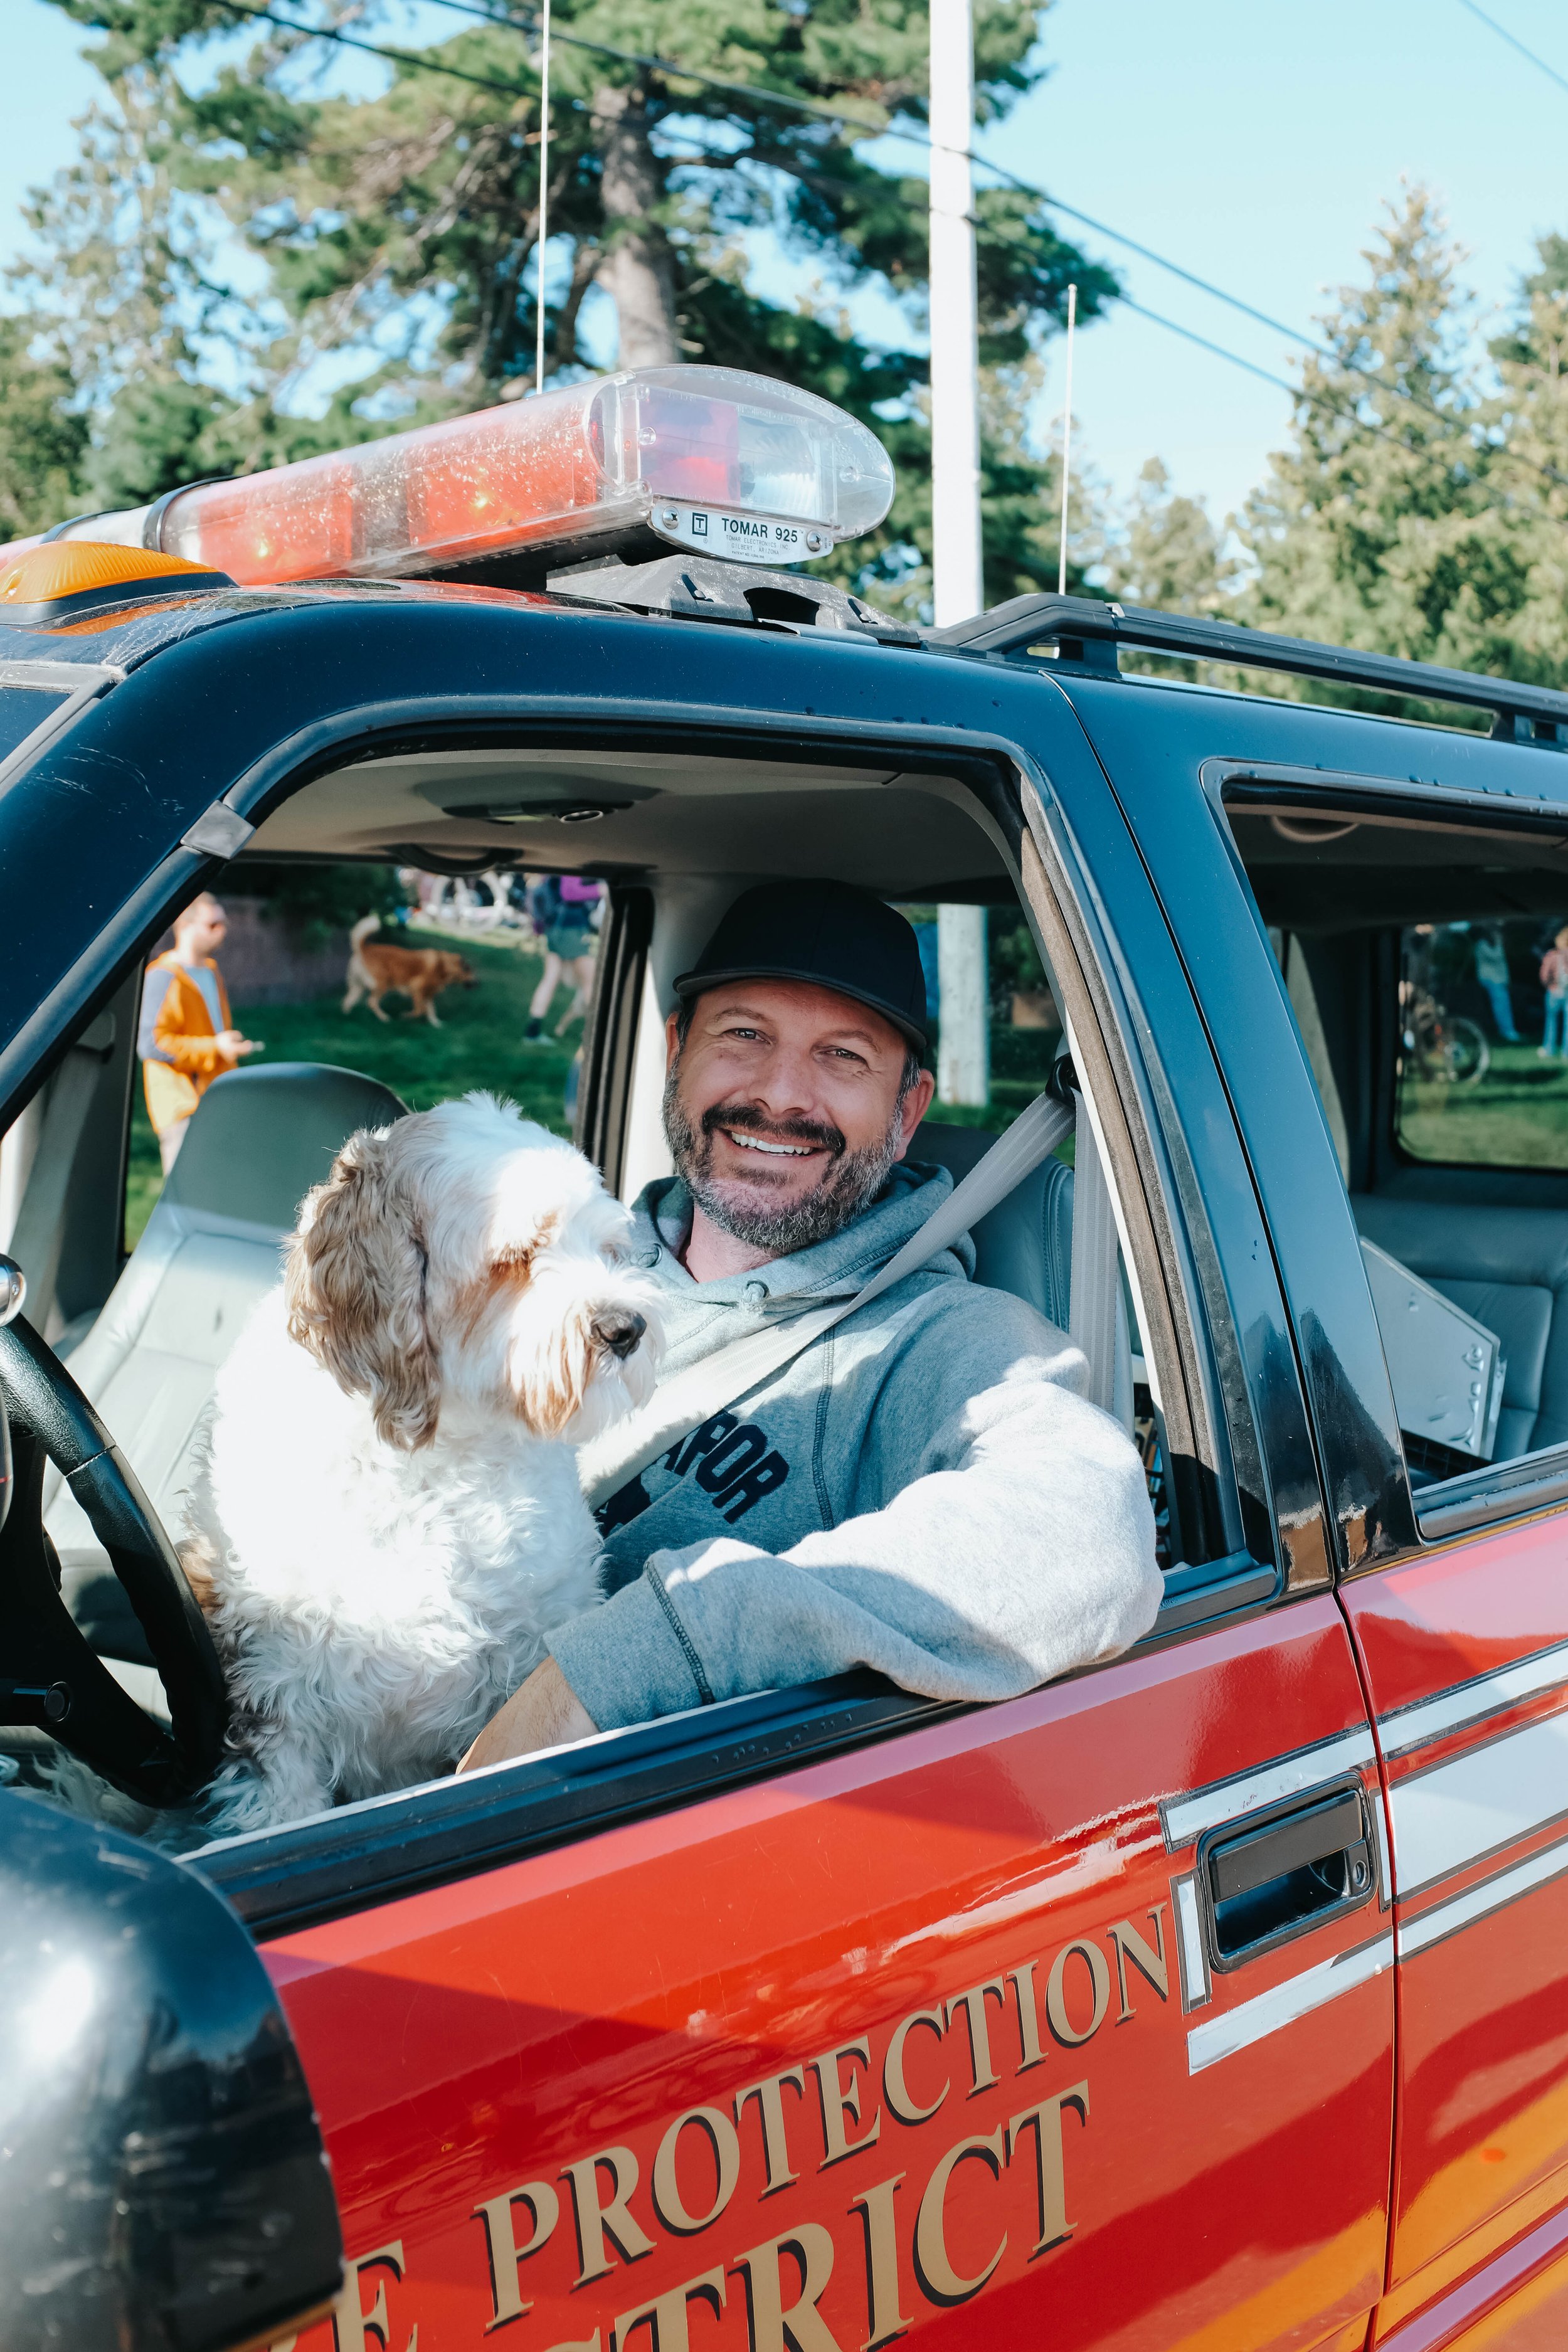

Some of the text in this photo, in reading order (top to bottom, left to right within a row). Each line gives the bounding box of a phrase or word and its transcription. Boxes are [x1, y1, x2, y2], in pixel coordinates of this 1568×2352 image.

[721, 517, 768, 538] TOMAR
[775, 527, 798, 543] 925
[744, 538, 776, 548] ELECTRONICS
[731, 543, 780, 556] GILBERT, ARIZONA
[470, 1902, 1170, 2336] PROTECTION
[543, 2080, 1090, 2352] TRICT
